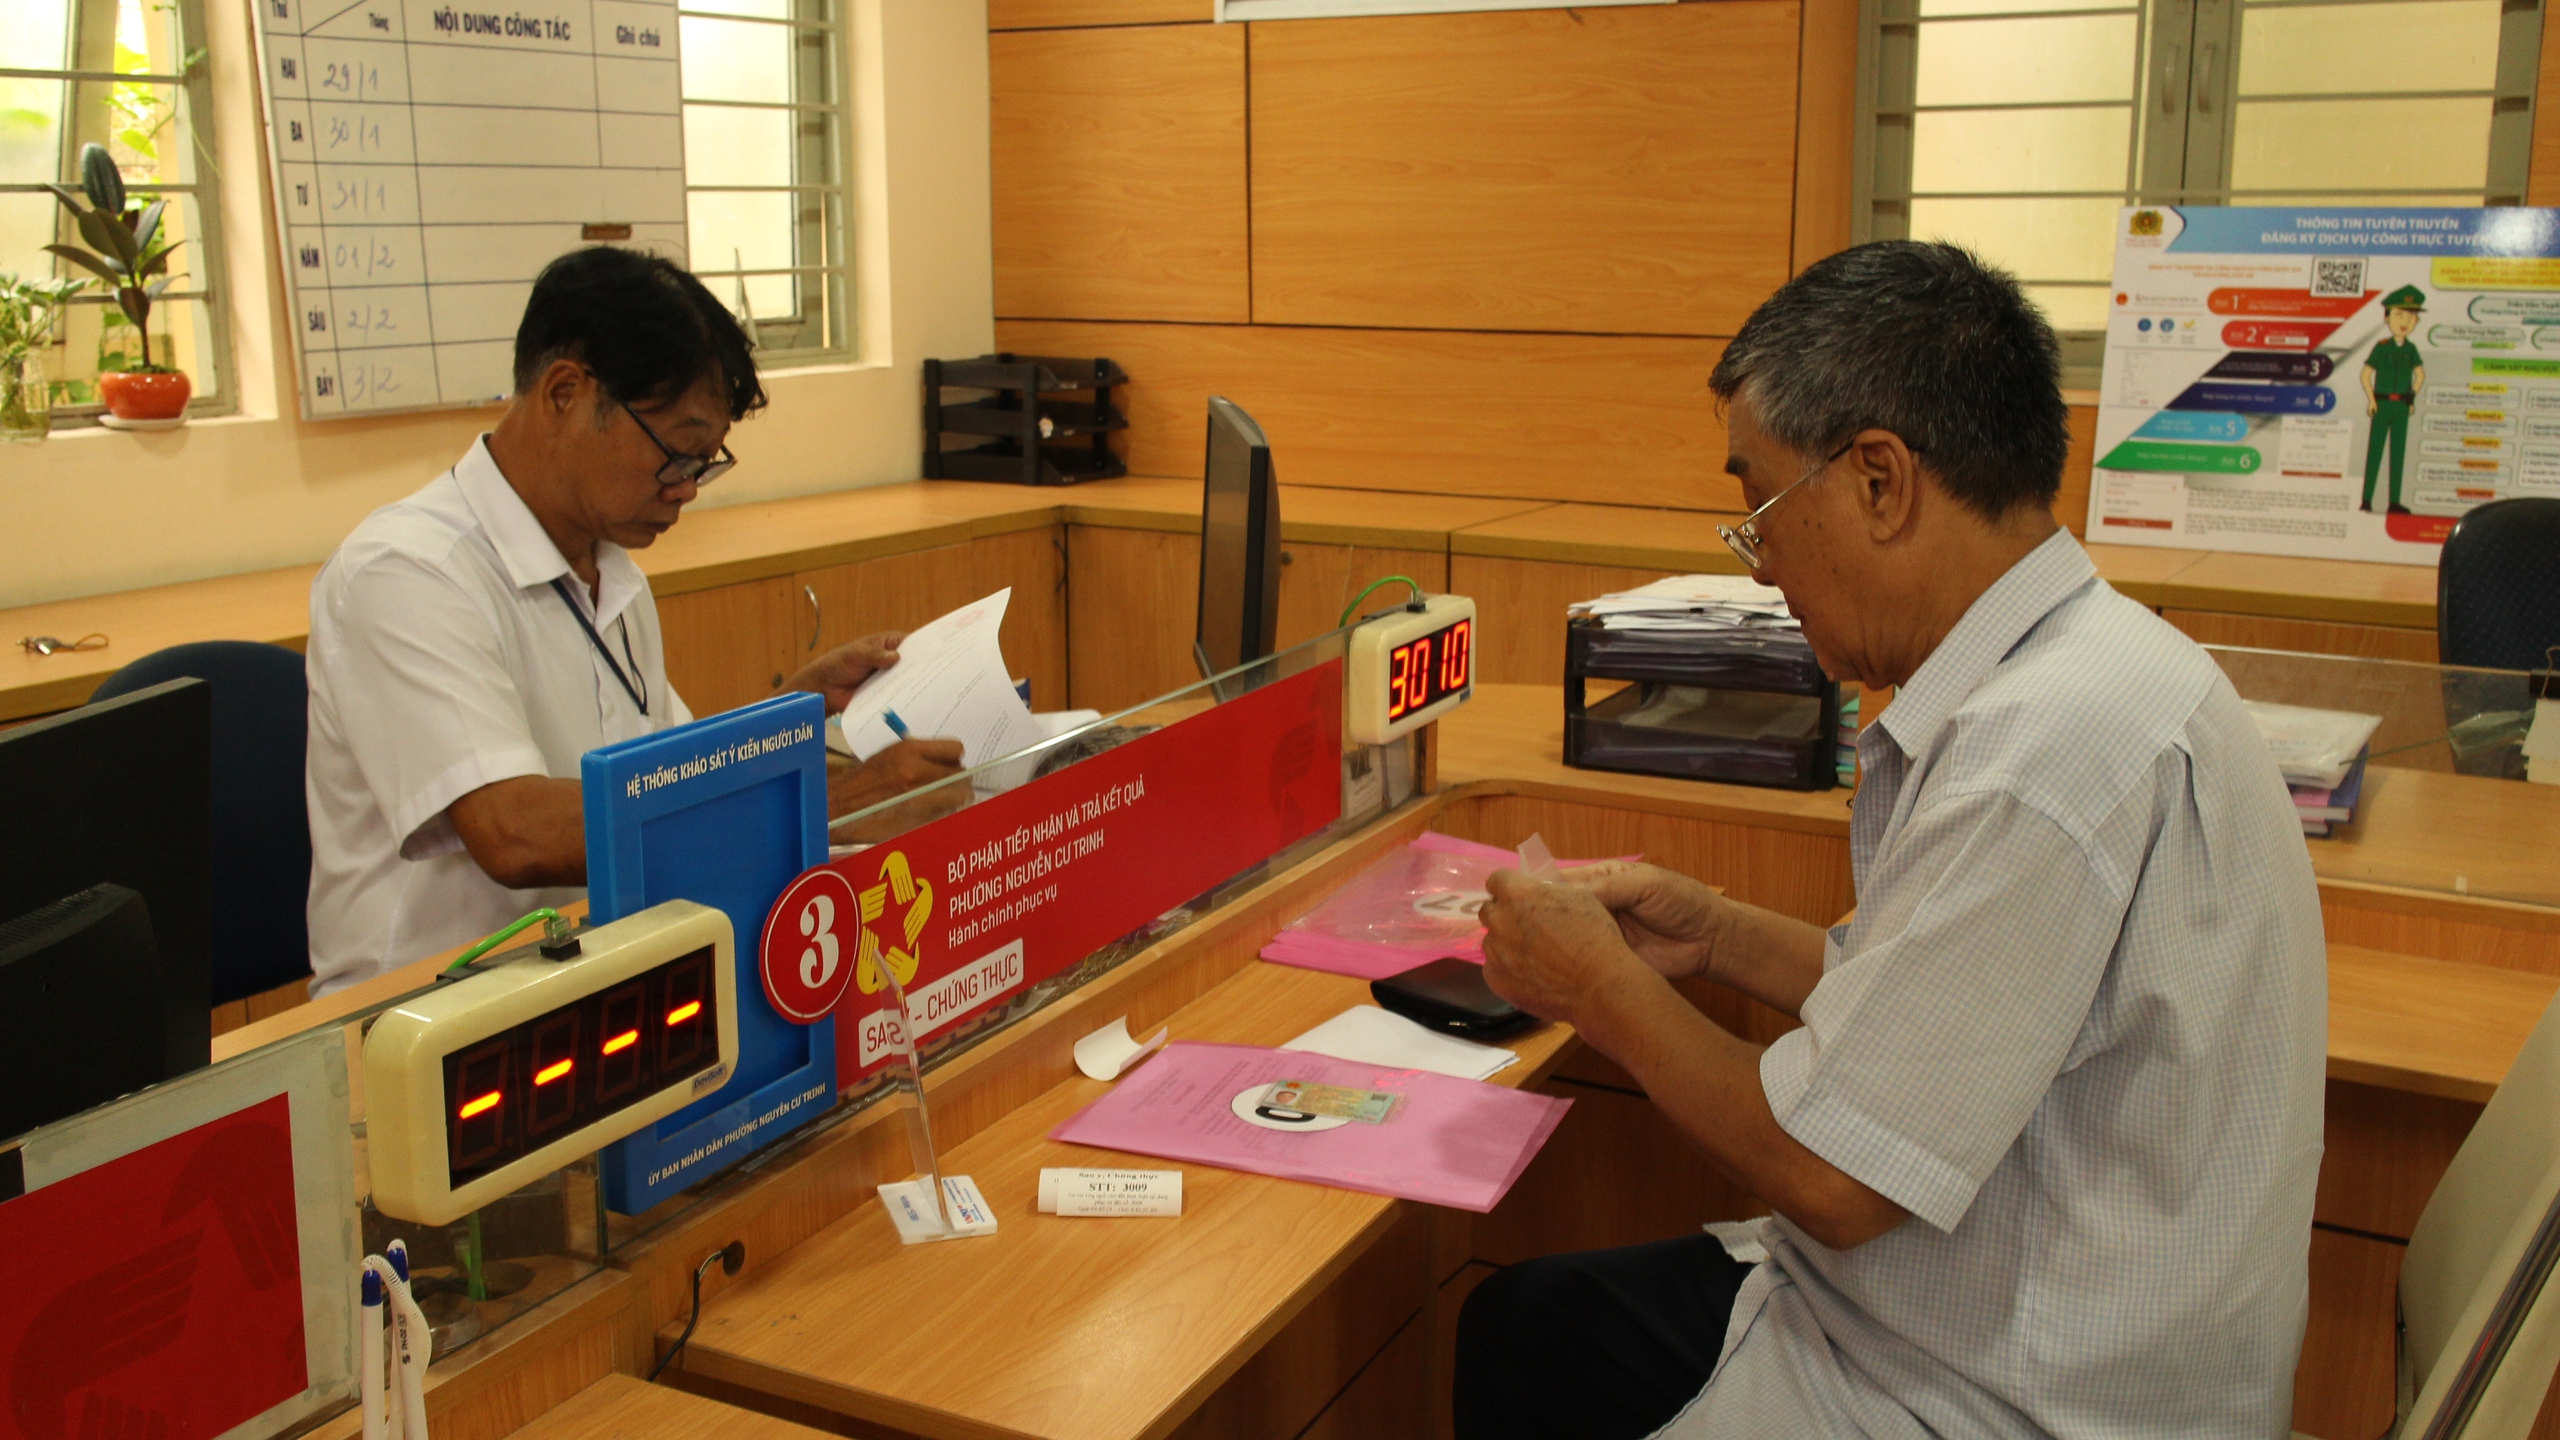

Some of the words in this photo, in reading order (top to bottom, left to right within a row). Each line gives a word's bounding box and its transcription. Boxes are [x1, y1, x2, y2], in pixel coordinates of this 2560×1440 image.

[434, 6, 459, 37] NỘI
[463, 13, 501, 35] DUNG
[505, 12, 541, 38] CÔNG
[545, 17, 571, 41] TÁC
[616, 25, 636, 45] Ghi
[280, 57, 297, 79] HAI
[290, 120, 303, 143] BA
[2296, 215, 2340, 230] THÔNG
[2343, 217, 2364, 229] TIN
[2410, 215, 2460, 230] TRUYỀN
[2261, 231, 2297, 245] ĐĂNG
[2318, 232, 2349, 246] DỊCH
[2371, 231, 2408, 246] CÔNG
[2246, 326, 2258, 343] 2
[2309, 360, 2320, 377] 3
[2313, 393, 2325, 409] 4
[2226, 420, 2236, 437] 5
[2240, 454, 2251, 469] 6
[1388, 620, 1470, 719] 3010
[626, 772, 641, 799] HỆ
[643, 764, 678, 792] THỐNG
[680, 755, 707, 780] KHẢO
[709, 747, 727, 771] SÁT
[729, 743, 736, 764] Ý
[737, 737, 760, 762] KIẾN
[762, 728, 793, 755] NGƯỜI
[794, 721, 813, 743] DÂN
[948, 852, 966, 884] BỘ
[970, 840, 1002, 874] PHẬN
[1005, 825, 1030, 857] TIẾP
[1033, 813, 1063, 845] NHẬN
[1066, 804, 1080, 830] VÀ
[1081, 793, 1101, 824] TRẢ
[1102, 784, 1121, 815] KẾT
[1124, 773, 1145, 806] QUẢ
[950, 876, 1002, 919] PHƯỜNG
[1005, 850, 1052, 892] NGUYỄN
[1055, 842, 1072, 869] CƯ
[1073, 828, 1104, 860] TRINH
[948, 918, 979, 950] Hành
[981, 901, 1013, 933] chính
[1015, 890, 1043, 921] phục
[1045, 883, 1057, 902] vụ
[799, 894, 839, 989] 3
[927, 973, 978, 1021] CHỨNG
[981, 953, 1018, 992] THỰC
[662, 1160, 679, 1180] BAN
[681, 1149, 705, 1171] NHÂN
[706, 1138, 723, 1156] DÂN
[724, 1121, 758, 1147] PHƯỜNG
[759, 1102, 790, 1128] NGUYỄN
[791, 1097, 801, 1110] CƯ
[803, 1083, 826, 1103] TRINH
[1089, 1183, 1116, 1192] STT:
[1122, 1183, 1148, 1192] 3009
